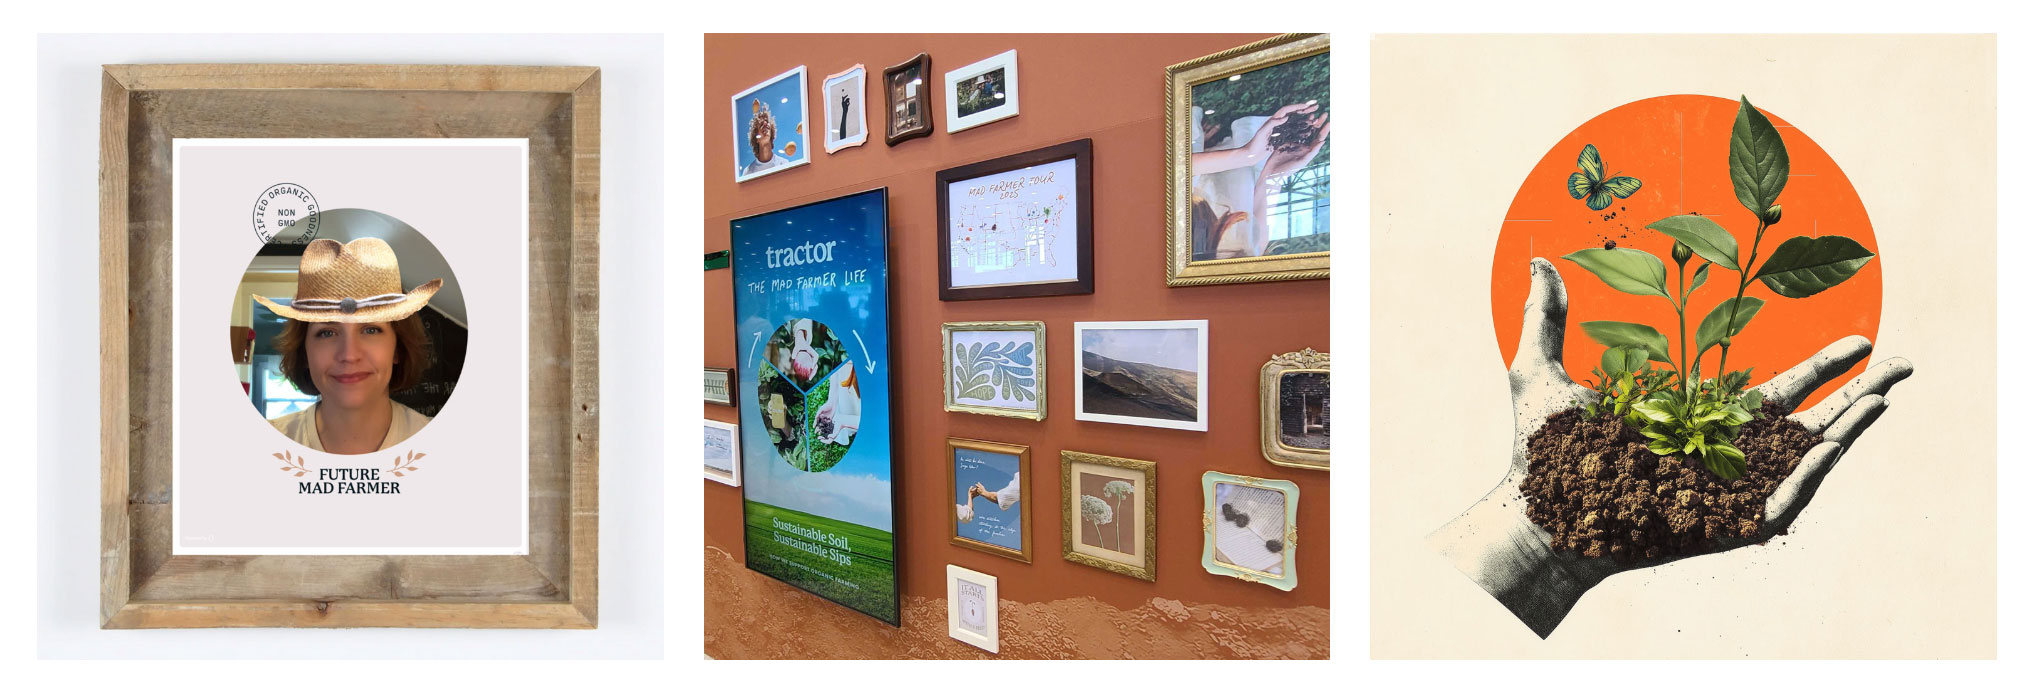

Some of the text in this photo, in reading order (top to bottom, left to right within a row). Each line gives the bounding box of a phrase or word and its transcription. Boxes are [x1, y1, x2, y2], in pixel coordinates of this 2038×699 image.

[968, 171, 1055, 197] MAD FARMER TOUR
[268, 186, 310, 203] ORGANIC
[1000, 189, 1020, 200] 2025
[277, 208, 296, 217] NON
[277, 219, 296, 227] GMO
[765, 240, 837, 269] tractor
[747, 269, 868, 294] THE MAD FARMER LIFE
[971, 386, 993, 400] HOPE
[319, 468, 380, 481] FUTURE
[298, 482, 401, 494] MAD FARMER
[772, 516, 852, 553] Sustainable Soil,
[773, 531, 852, 566] Sustainable Sips
[789, 560, 810, 572] SUPPORT
[810, 568, 834, 581] ORGANIC
[835, 576, 860, 590] FARMING
